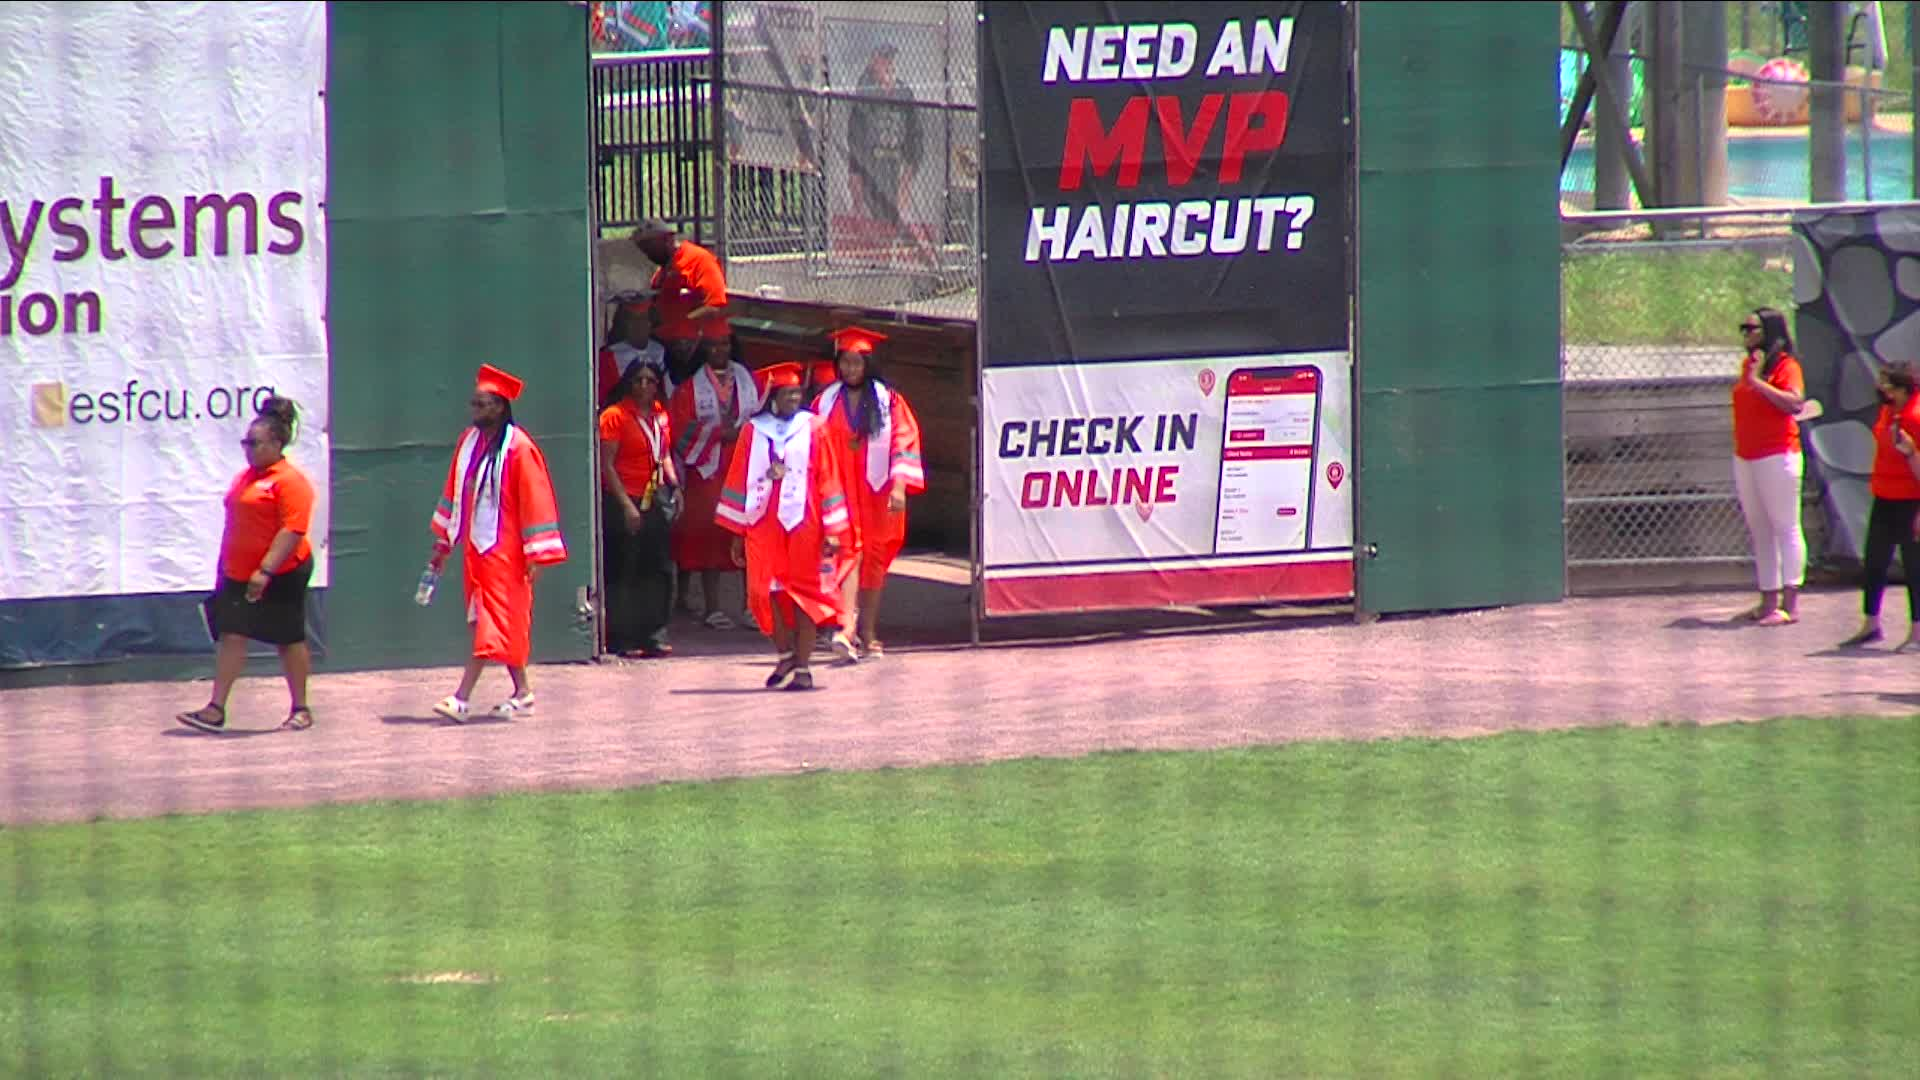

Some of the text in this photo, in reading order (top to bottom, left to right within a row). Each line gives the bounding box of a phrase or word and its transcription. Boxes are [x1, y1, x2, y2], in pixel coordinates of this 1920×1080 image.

[1043, 17, 1295, 82] NEED AN
[1059, 90, 1290, 190] MVP
[0, 176, 304, 291] ystems
[1025, 196, 1315, 262] HAIRCUT?
[998, 413, 1198, 458] CHECK IN
[1020, 466, 1180, 509] ONLINE
